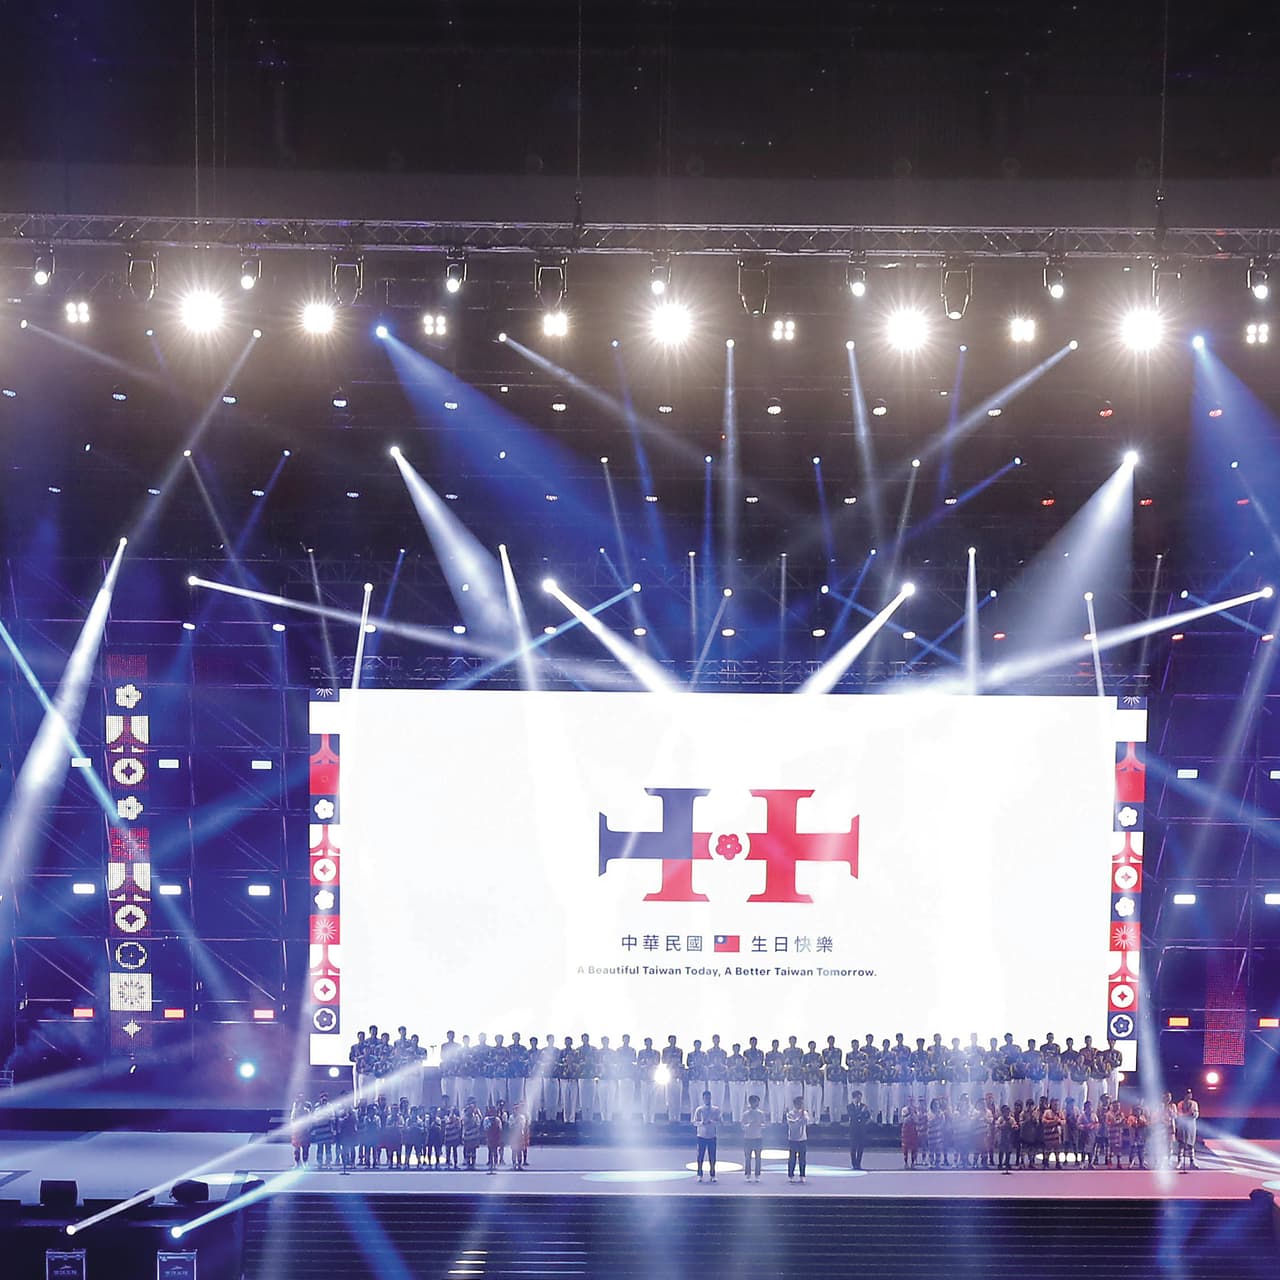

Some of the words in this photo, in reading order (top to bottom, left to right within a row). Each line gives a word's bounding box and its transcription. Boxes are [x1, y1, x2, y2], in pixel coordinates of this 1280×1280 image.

[622, 934, 703, 952] 中華民國
[751, 936, 833, 953] 生日快樂
[577, 966, 584, 974] A
[588, 965, 639, 975] Beautiful
[643, 965, 682, 975] Taiwan
[685, 966, 721, 977] Today,
[724, 967, 732, 976] A
[735, 967, 771, 976] Better
[775, 967, 813, 976] Taiwan
[816, 967, 877, 977] Tomorrow.
